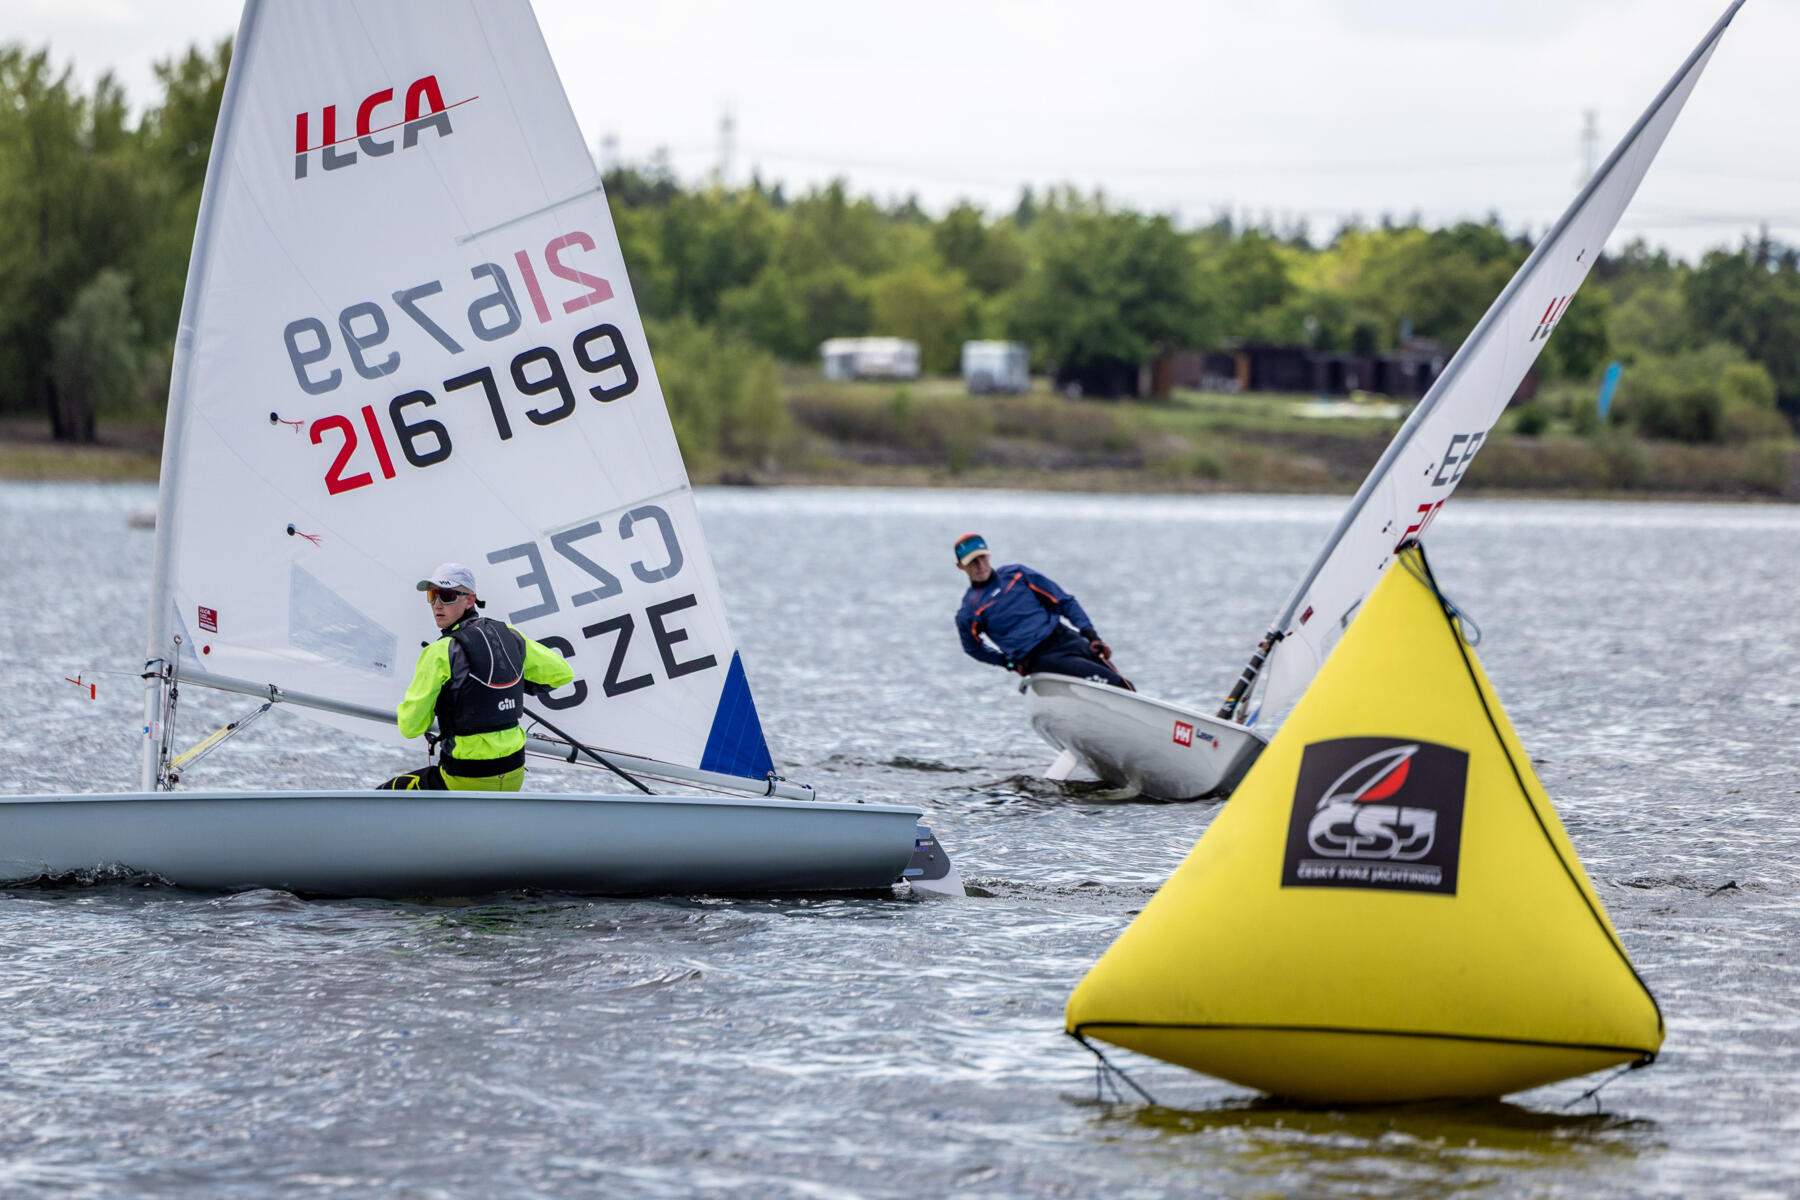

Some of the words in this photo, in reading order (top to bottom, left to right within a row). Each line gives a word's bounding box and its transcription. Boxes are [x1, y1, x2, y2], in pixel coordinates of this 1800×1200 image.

[295, 75, 453, 180] ILCA
[309, 323, 639, 495] 216799
[498, 698, 516, 711] Gill
